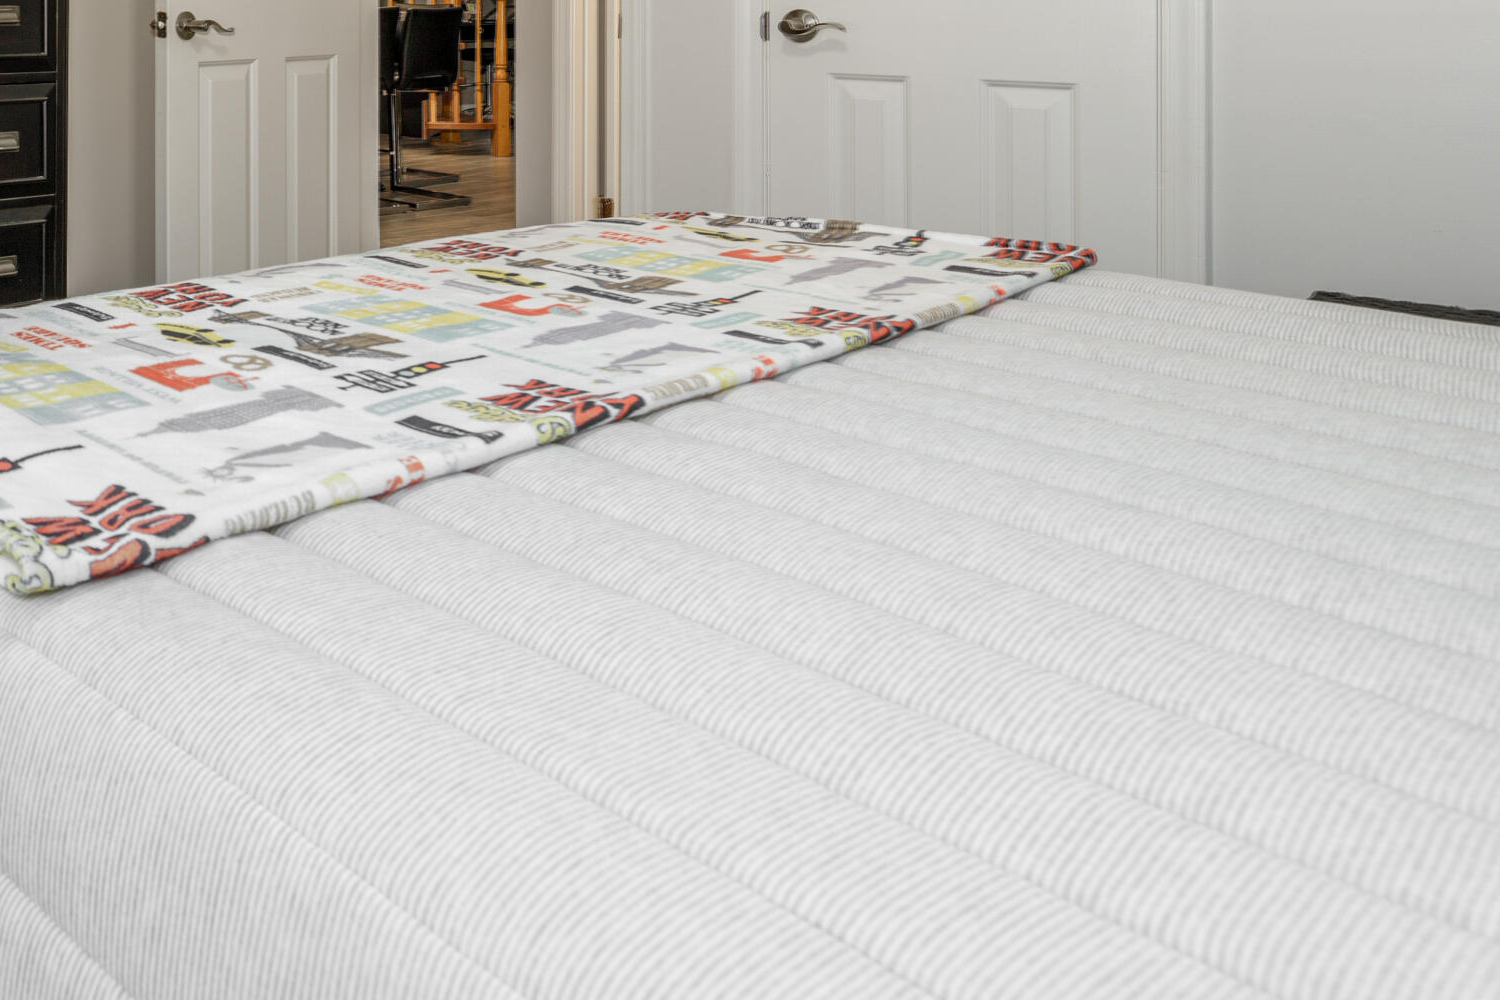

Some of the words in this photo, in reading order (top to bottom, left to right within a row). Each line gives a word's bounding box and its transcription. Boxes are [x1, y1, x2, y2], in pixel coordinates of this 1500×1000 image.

[128, 288, 211, 311] NEW
[6, 331, 67, 350] TIMES
[20, 325, 93, 348] SQUARE
